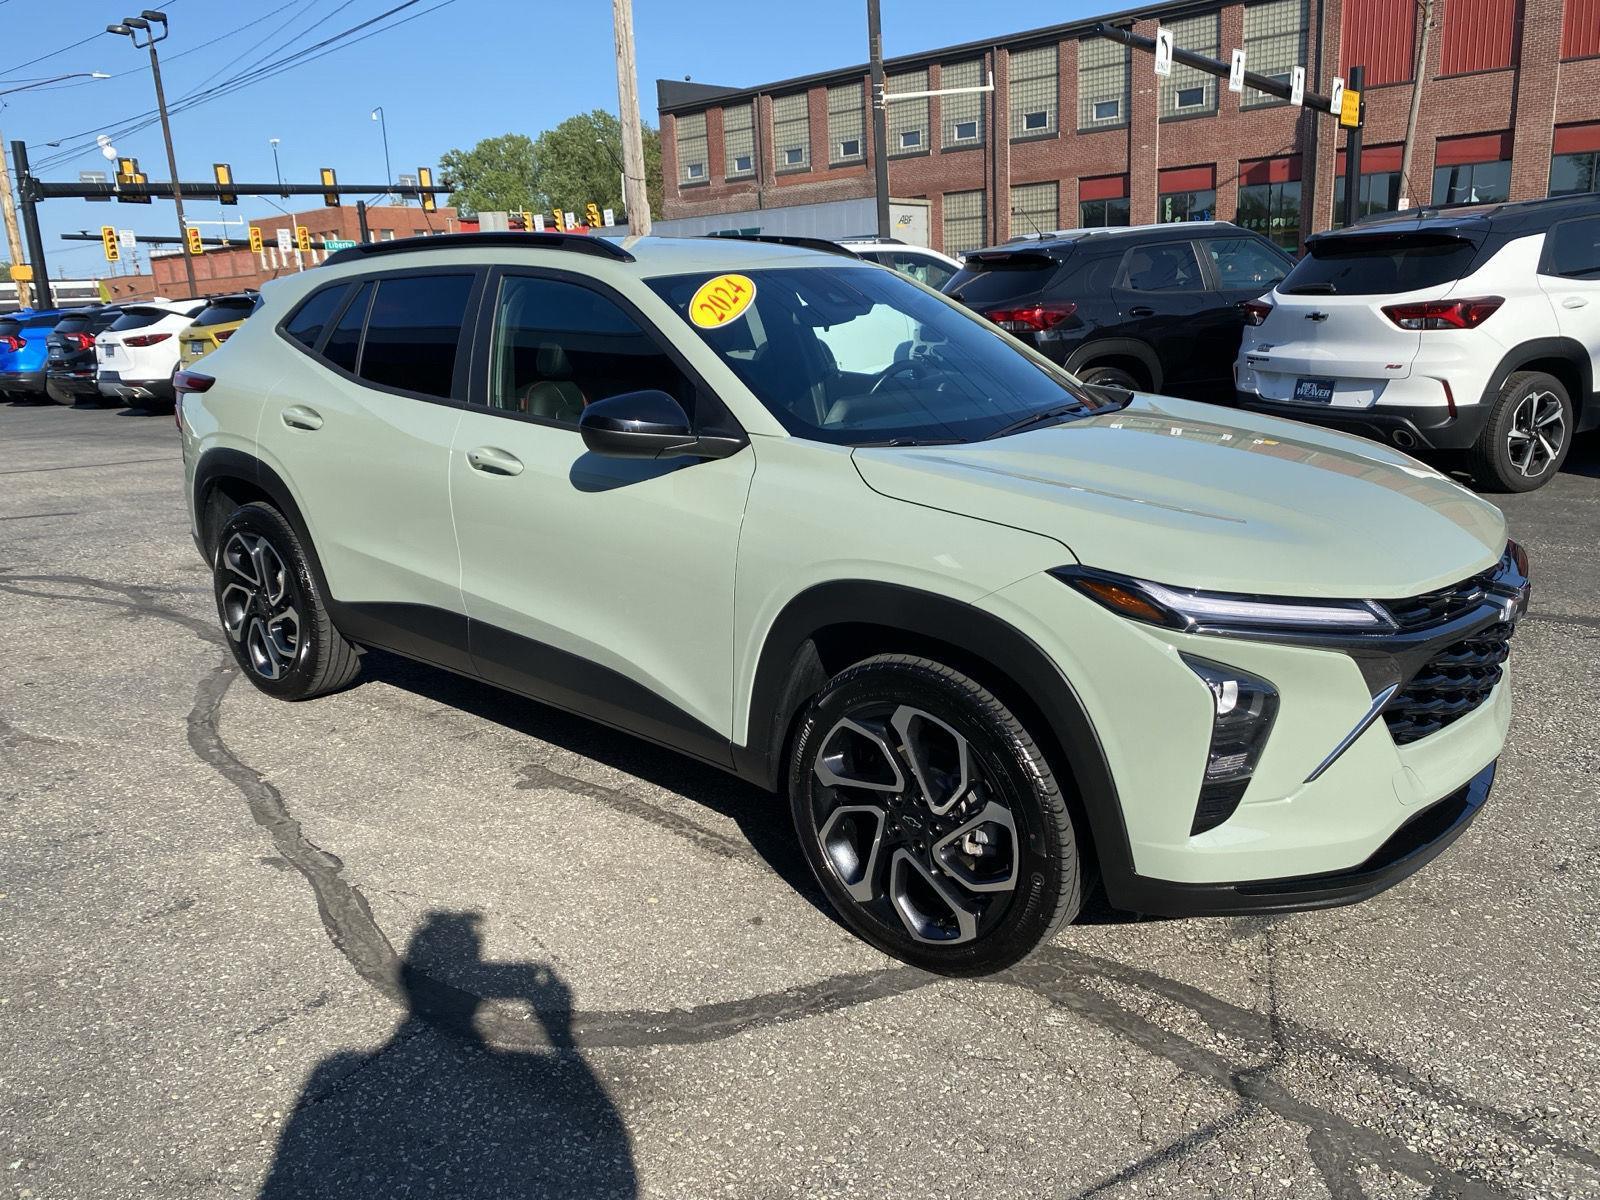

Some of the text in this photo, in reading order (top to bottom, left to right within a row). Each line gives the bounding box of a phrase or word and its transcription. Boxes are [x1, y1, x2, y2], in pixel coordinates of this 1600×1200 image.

[899, 215, 912, 224] ABF
[700, 278, 746, 322] 2024
[1301, 382, 1318, 391] RICK
[1297, 388, 1331, 397] WEAVER
